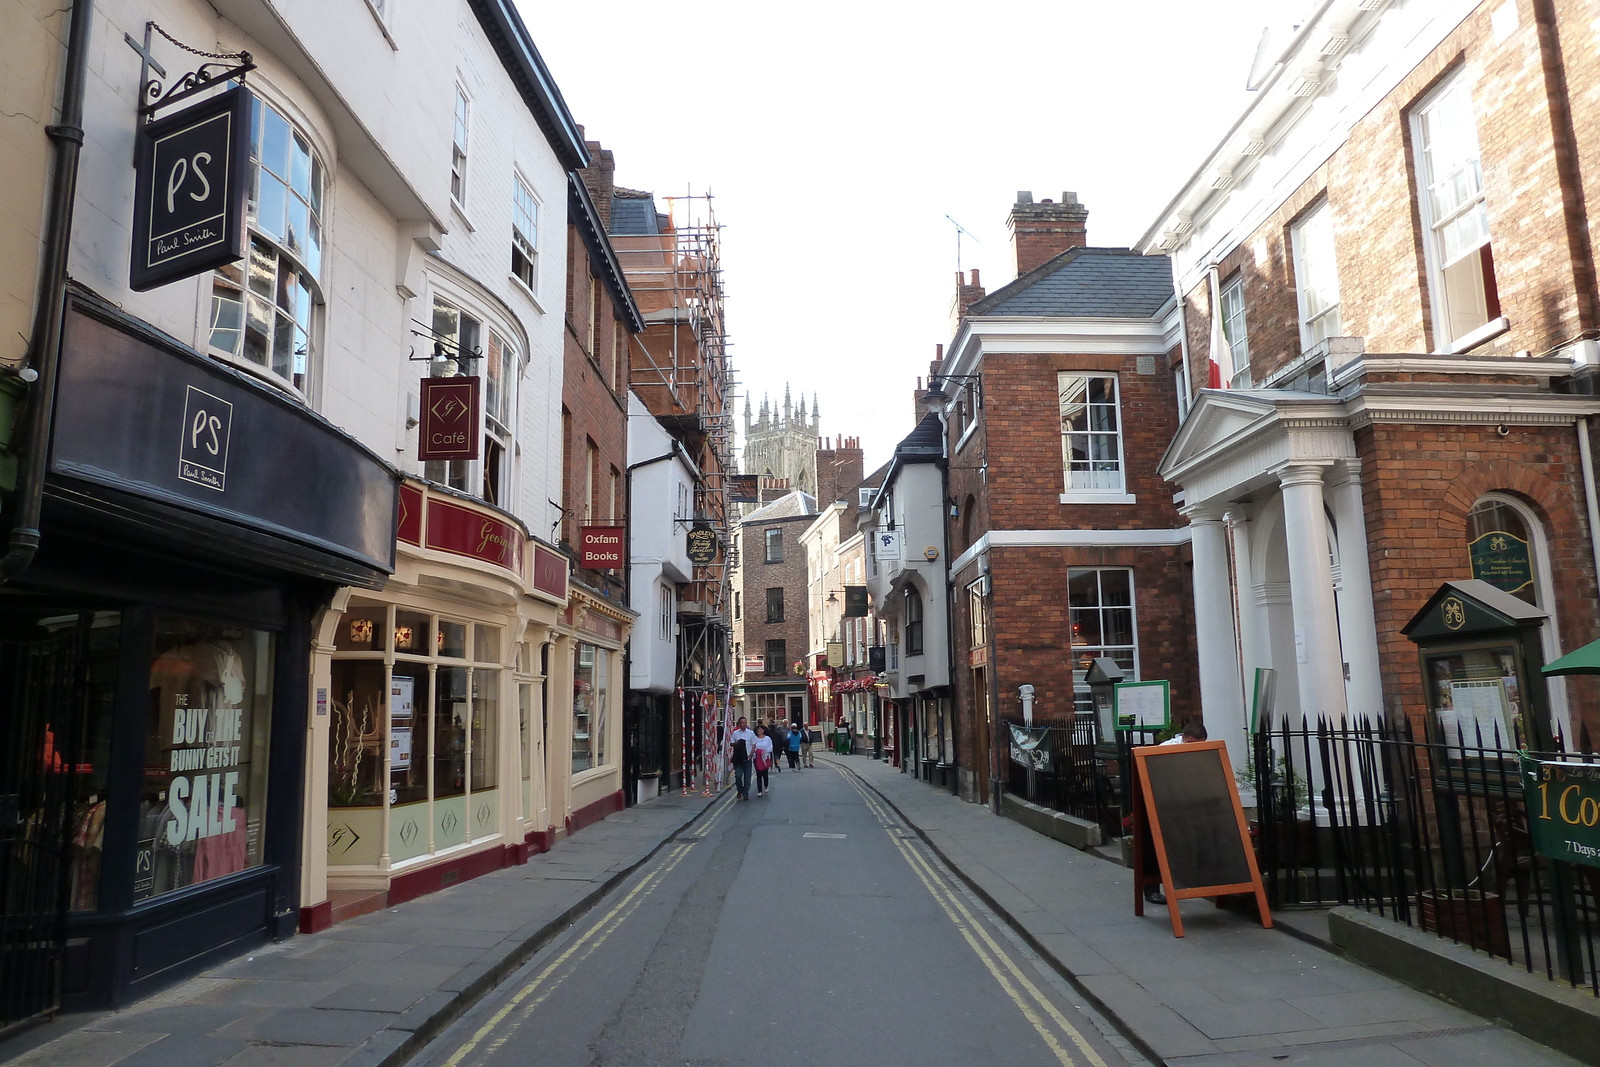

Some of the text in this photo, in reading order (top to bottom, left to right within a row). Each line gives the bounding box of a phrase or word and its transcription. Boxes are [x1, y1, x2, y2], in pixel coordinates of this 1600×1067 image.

[167, 151, 212, 214] PS
[157, 228, 217, 255] Paul Smith
[192, 409, 222, 455] PS
[432, 432, 466, 445] Café
[585, 534, 619, 545] Oxfam
[585, 551, 619, 561] Books
[175, 693, 189, 706] THE
[172, 708, 209, 745] BUY
[215, 708, 243, 742] THE
[170, 748, 207, 773] BUNNY
[206, 746, 230, 770] GETS
[230, 746, 241, 767] IT
[167, 771, 240, 846] SALE
[1537, 782, 1600, 828] 1 Co
[136, 850, 151, 874] PS
[1564, 840, 1571, 852] 7
[1572, 841, 1597, 859] Days
